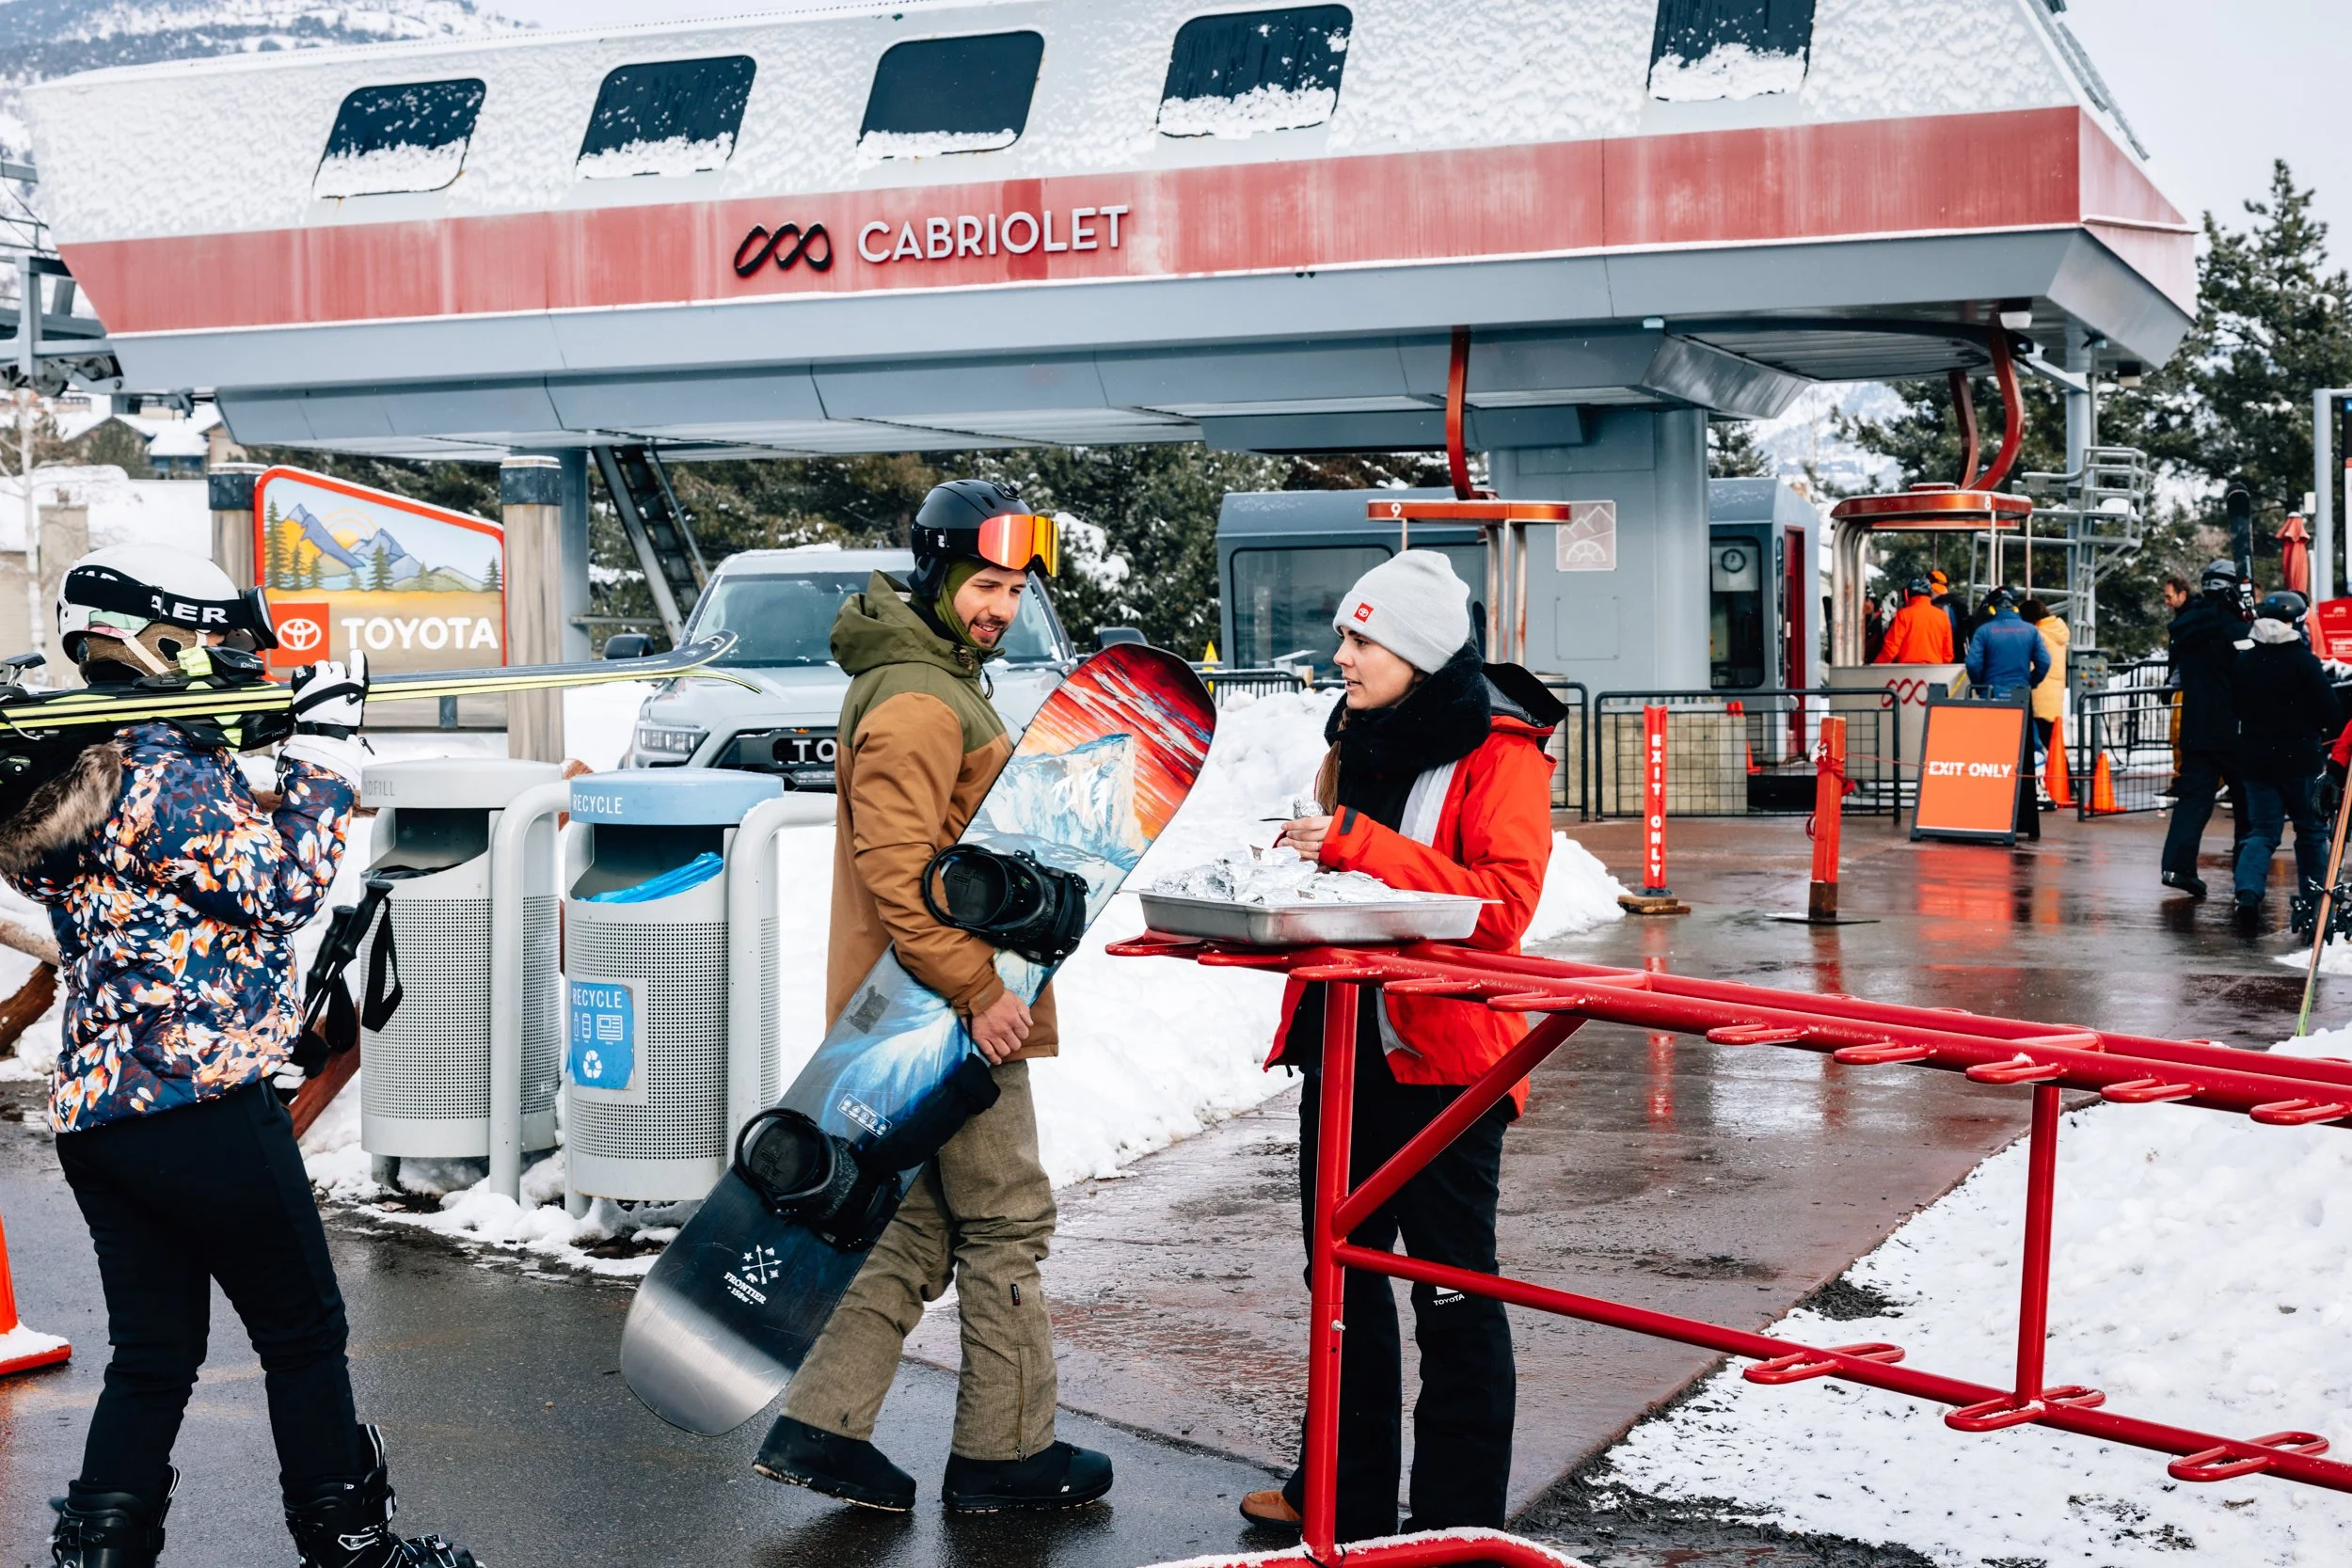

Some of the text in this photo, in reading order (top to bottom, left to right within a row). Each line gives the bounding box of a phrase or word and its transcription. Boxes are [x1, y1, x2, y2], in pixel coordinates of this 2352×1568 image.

[857, 205, 1129, 263] CABRIOLET
[1391, 503, 1402, 517] 9
[1984, 495, 1992, 511] 8
[341, 616, 500, 650] TOYOTA
[792, 738, 836, 763] TO
[1929, 761, 2012, 779] EXIT ONLY
[573, 793, 623, 816] RECYCLE
[1650, 734, 1662, 878] EXIT ONLY
[572, 988, 623, 1009] RECYCLE
[723, 1271, 767, 1305] FRONTIER
[1433, 1293, 1465, 1307] TOYOTA
